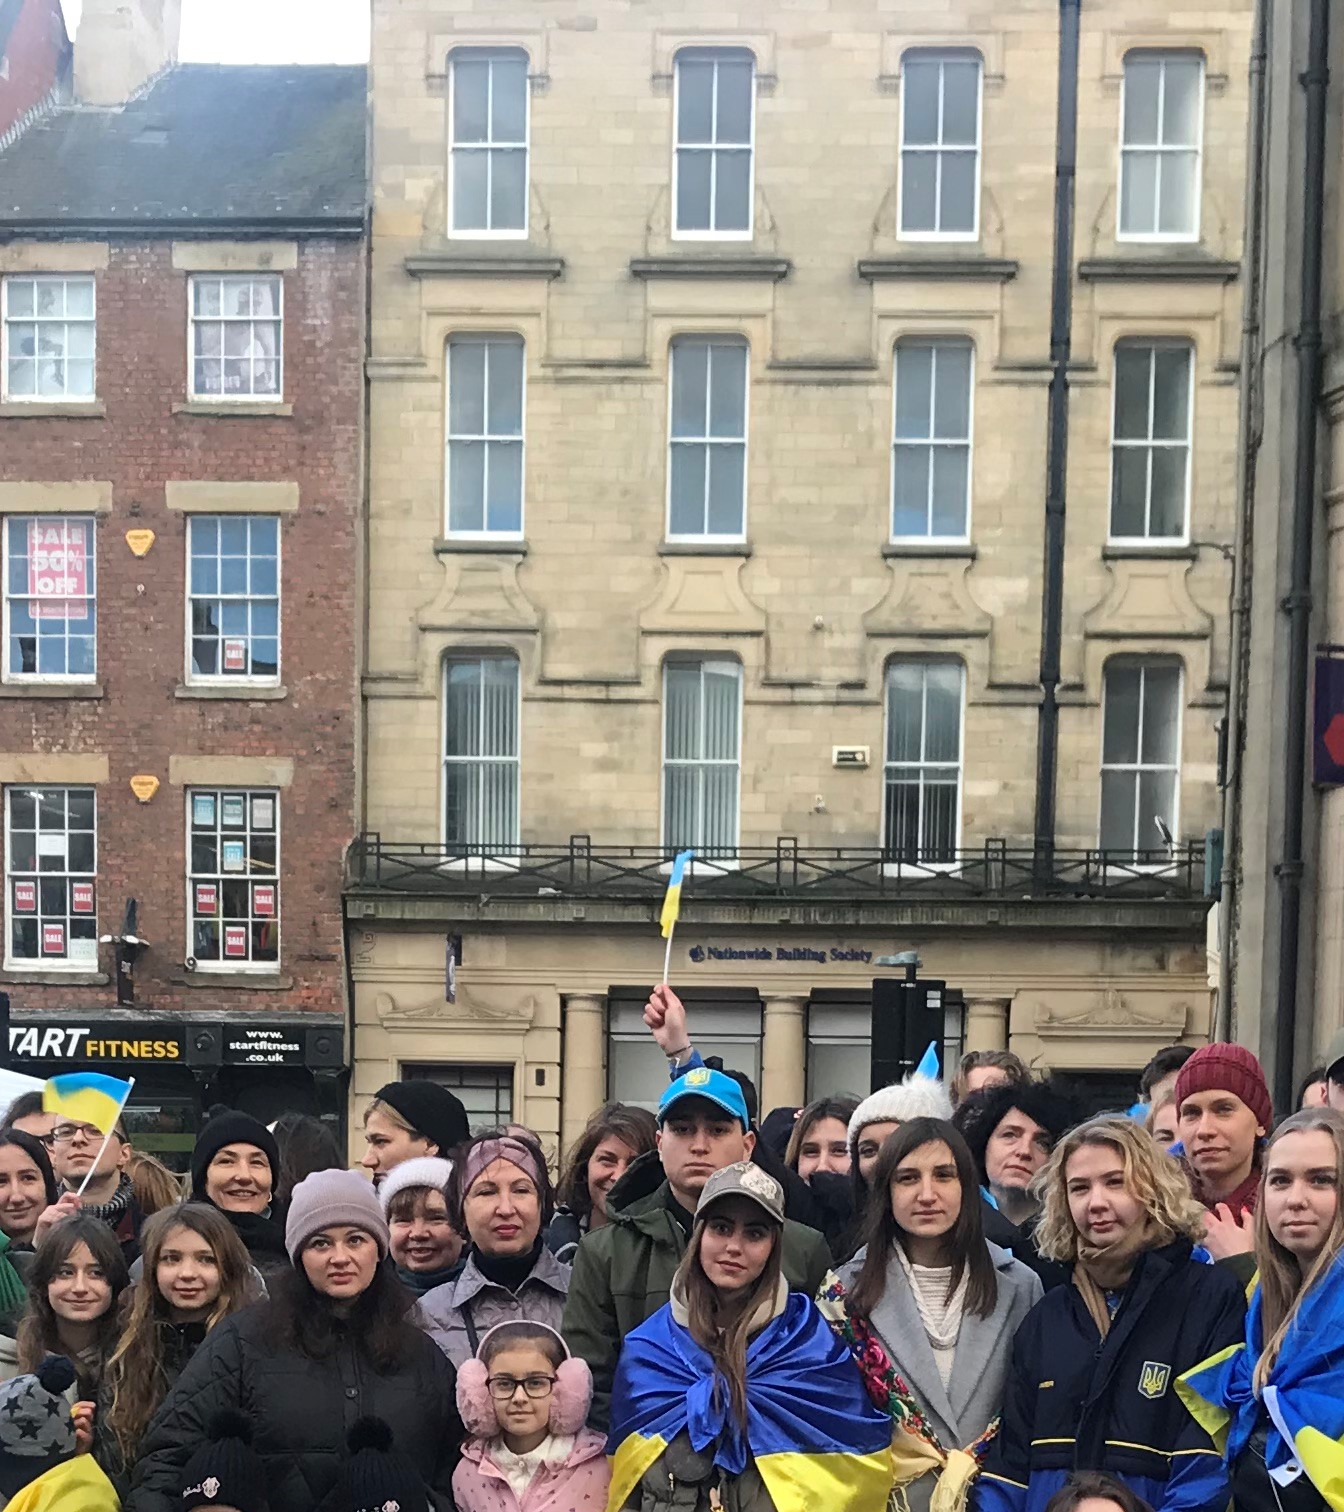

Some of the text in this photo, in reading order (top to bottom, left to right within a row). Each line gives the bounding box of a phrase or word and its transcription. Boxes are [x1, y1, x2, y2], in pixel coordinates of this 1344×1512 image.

[31, 527, 83, 545] SALE
[31, 550, 83, 572] 50%
[37, 577, 78, 593] OFF
[17, 891, 33, 901] SALE
[74, 892, 91, 902] SALE
[198, 894, 214, 903] SALE
[255, 895, 272, 904] SALE
[44, 934, 61, 943] SALE
[227, 936, 243, 946] SALE
[707, 946, 873, 964] Nationwide Building Society
[246, 1029, 283, 1039] www.
[86, 1040, 179, 1058] FITNESS
[229, 1039, 300, 1051] startfitness
[245, 1052, 284, 1063] .co.uk
